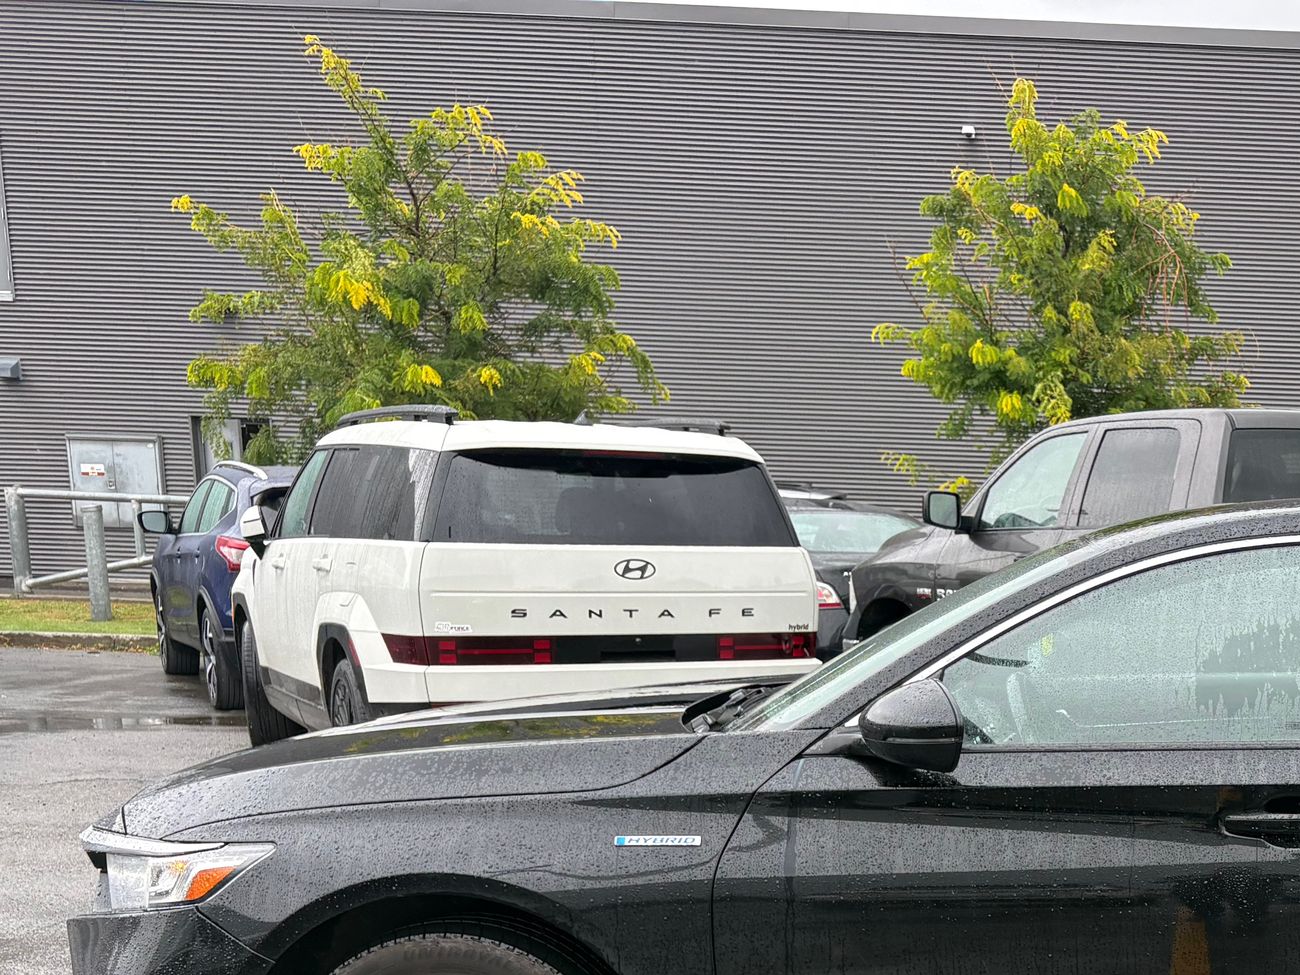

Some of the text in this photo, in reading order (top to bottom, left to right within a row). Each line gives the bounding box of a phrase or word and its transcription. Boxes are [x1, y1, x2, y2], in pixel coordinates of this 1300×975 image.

[510, 607, 755, 619] SANTA FE
[788, 623, 809, 632] hybrid
